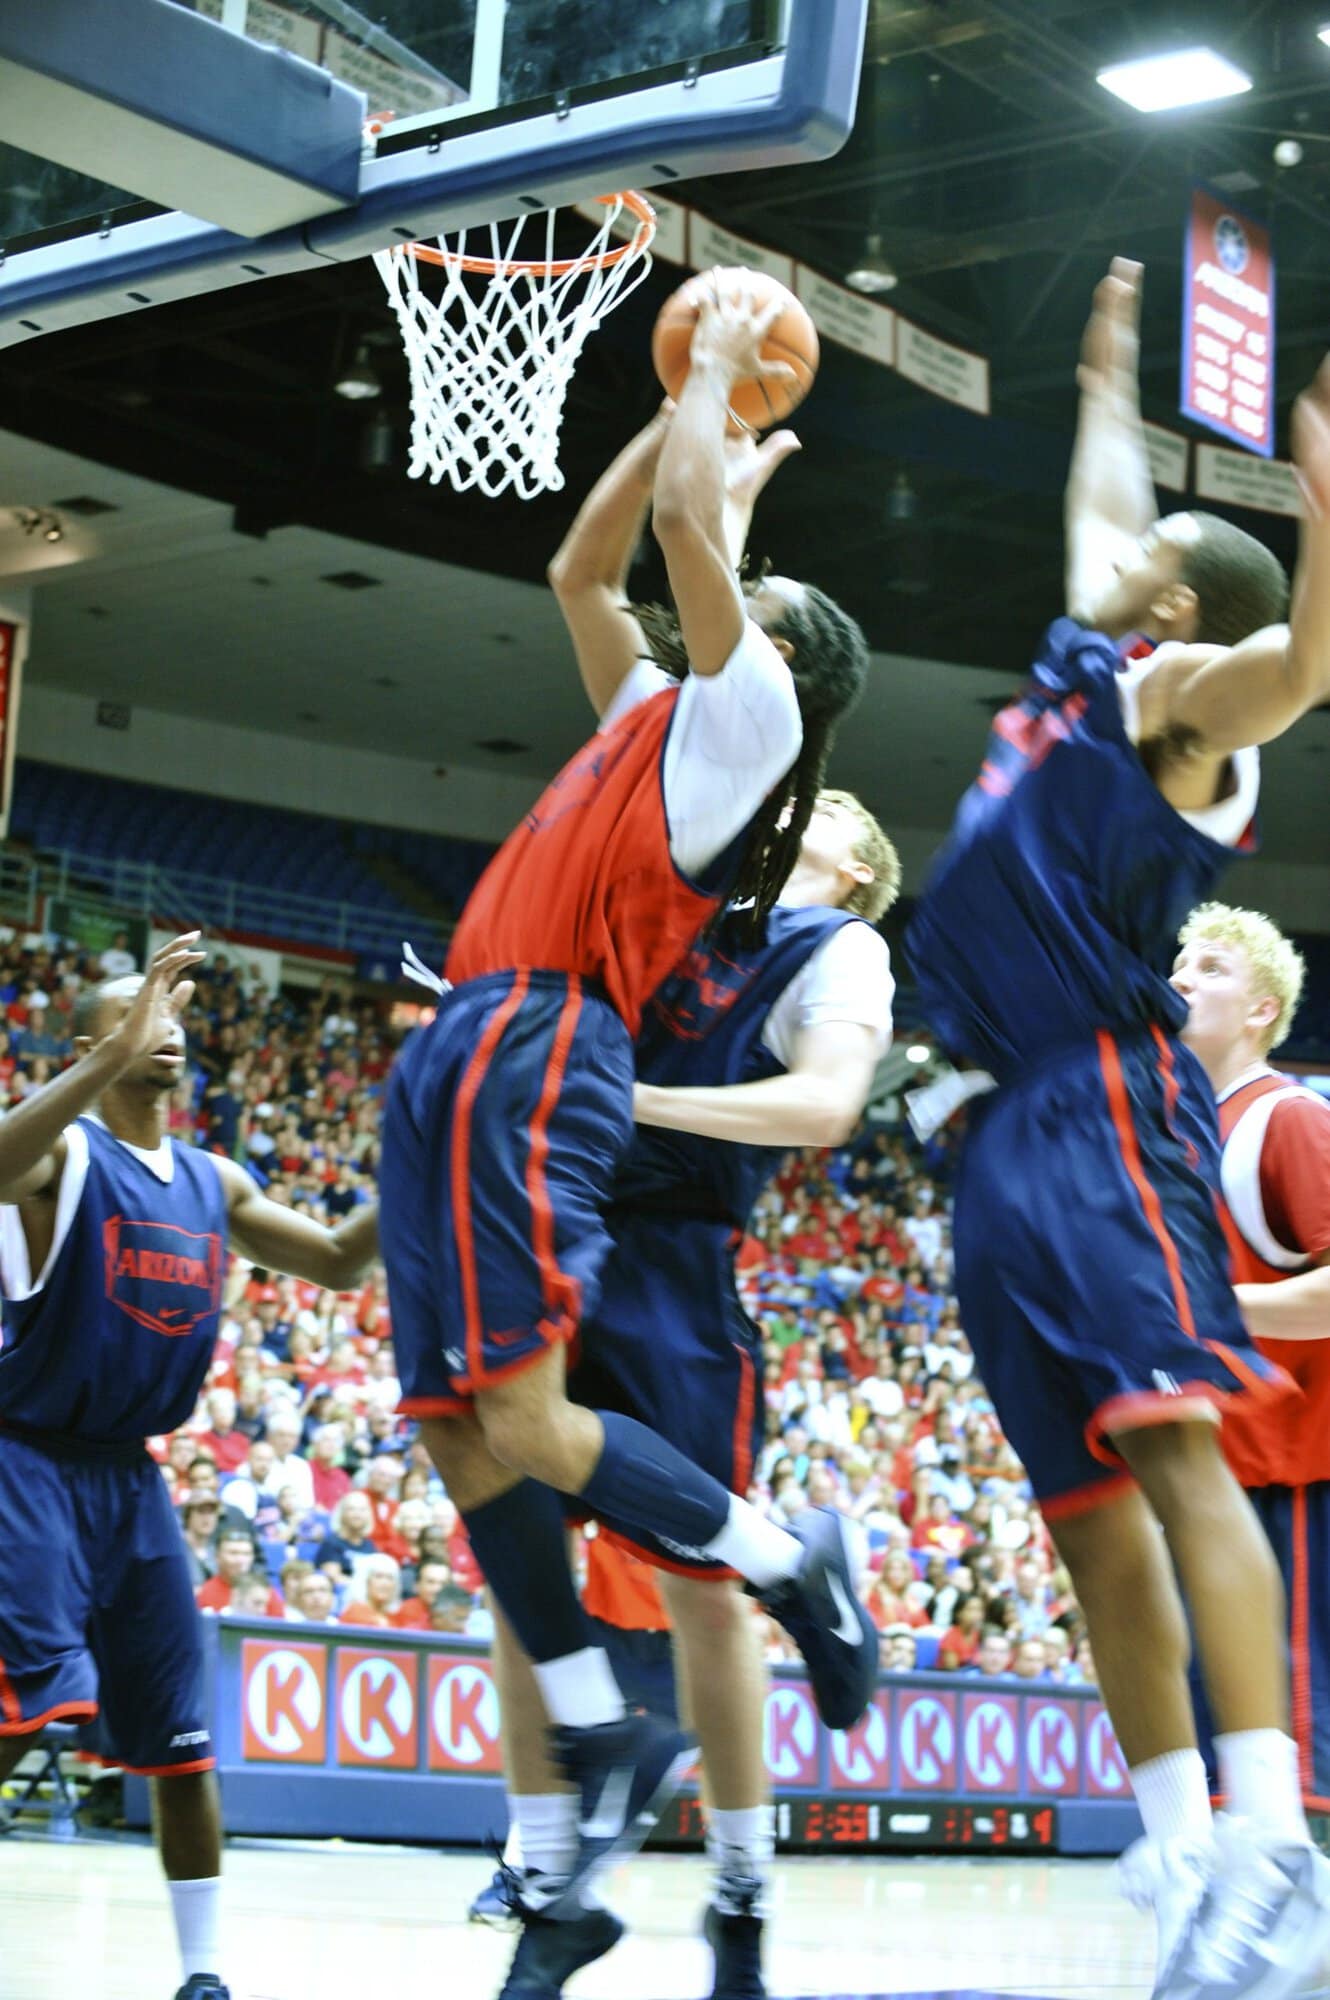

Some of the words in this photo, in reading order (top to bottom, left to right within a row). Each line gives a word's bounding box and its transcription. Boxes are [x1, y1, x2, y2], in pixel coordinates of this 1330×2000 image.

[264, 1660, 313, 1744] K
[357, 1668, 405, 1750] K
[913, 1707, 948, 1777] K
[976, 1712, 1010, 1779] K
[1038, 1716, 1073, 1781] K
